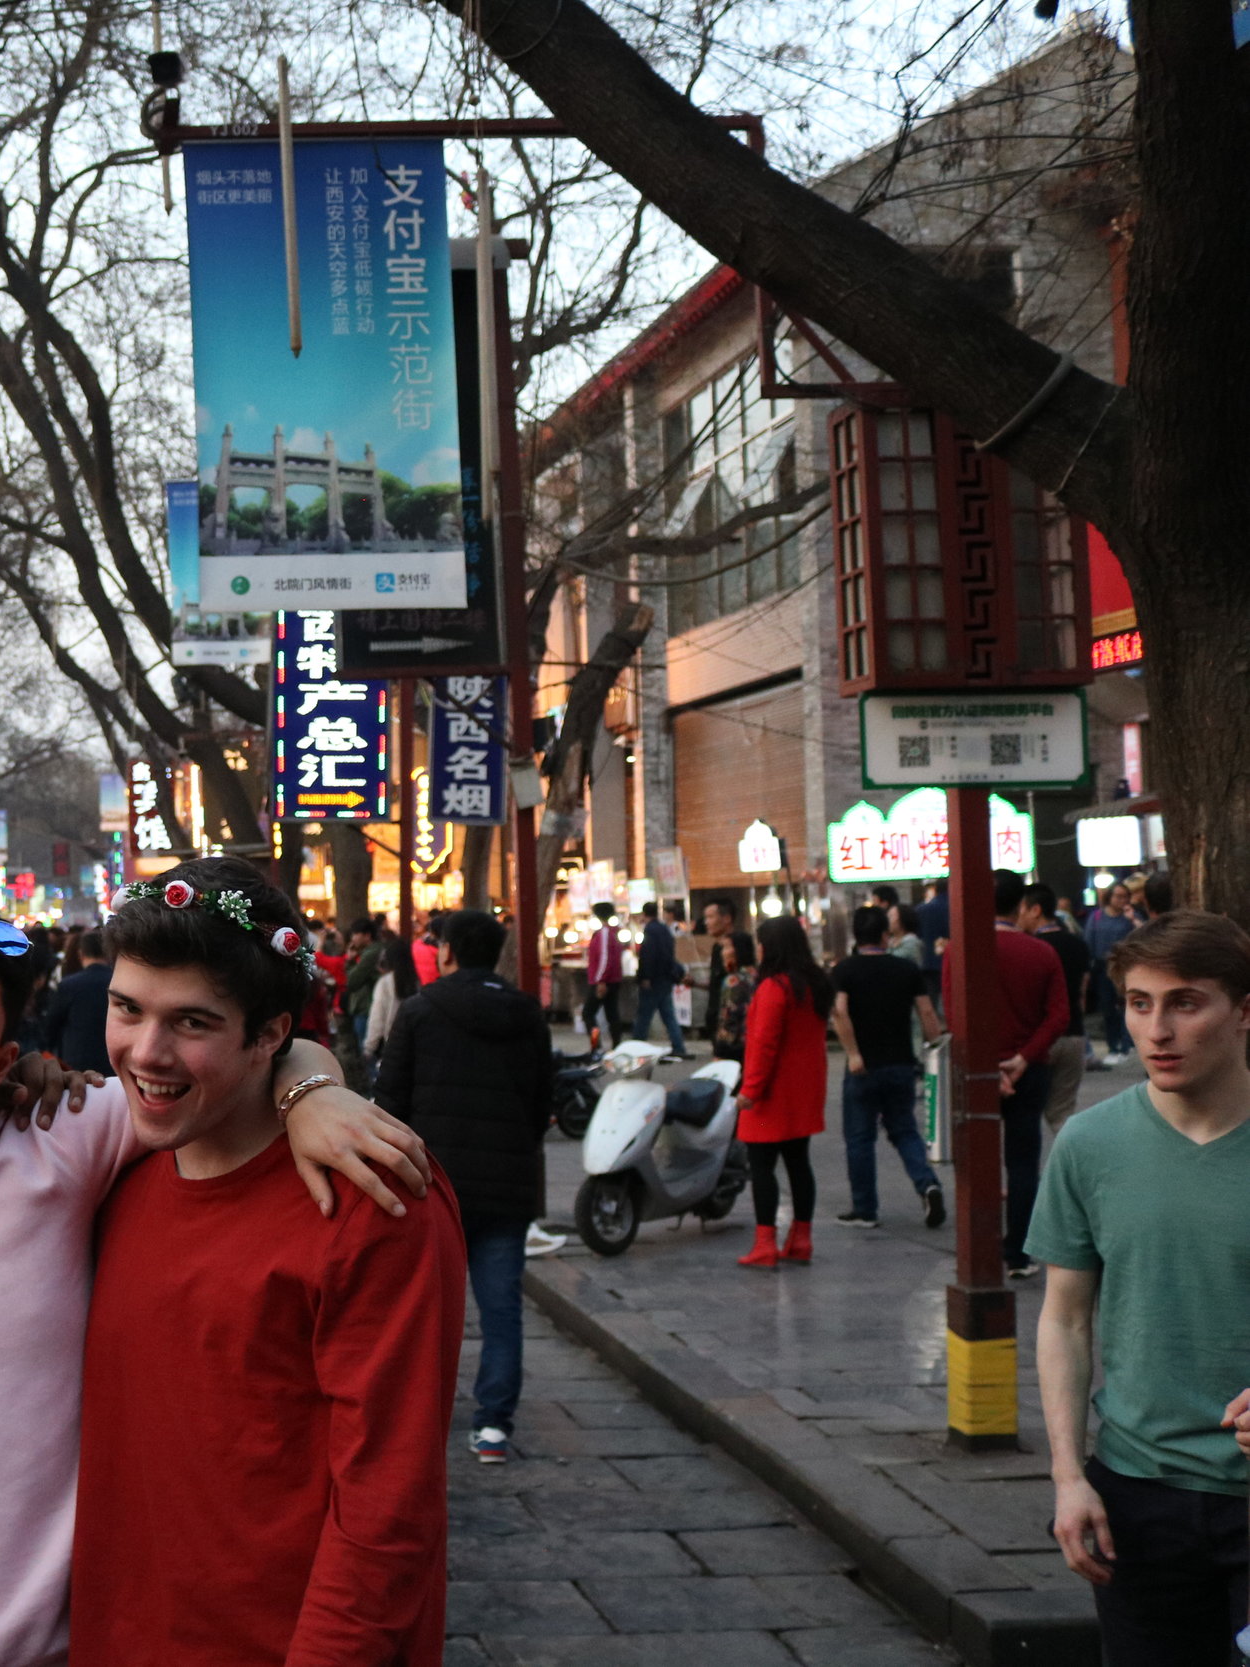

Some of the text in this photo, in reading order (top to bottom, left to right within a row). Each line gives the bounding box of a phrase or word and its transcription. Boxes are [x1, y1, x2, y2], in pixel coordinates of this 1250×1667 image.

[324, 168, 349, 335] 让西安的天空多点蓝
[350, 168, 375, 334] 加入支付宝低碳行动
[383, 164, 433, 430] 支付宝示范街
[274, 577, 352, 591] 北院门风情街
[398, 573, 430, 585] 支付宝
[442, 675, 495, 818] 陕西名烟
[840, 826, 1023, 870] 红柳烤肉
